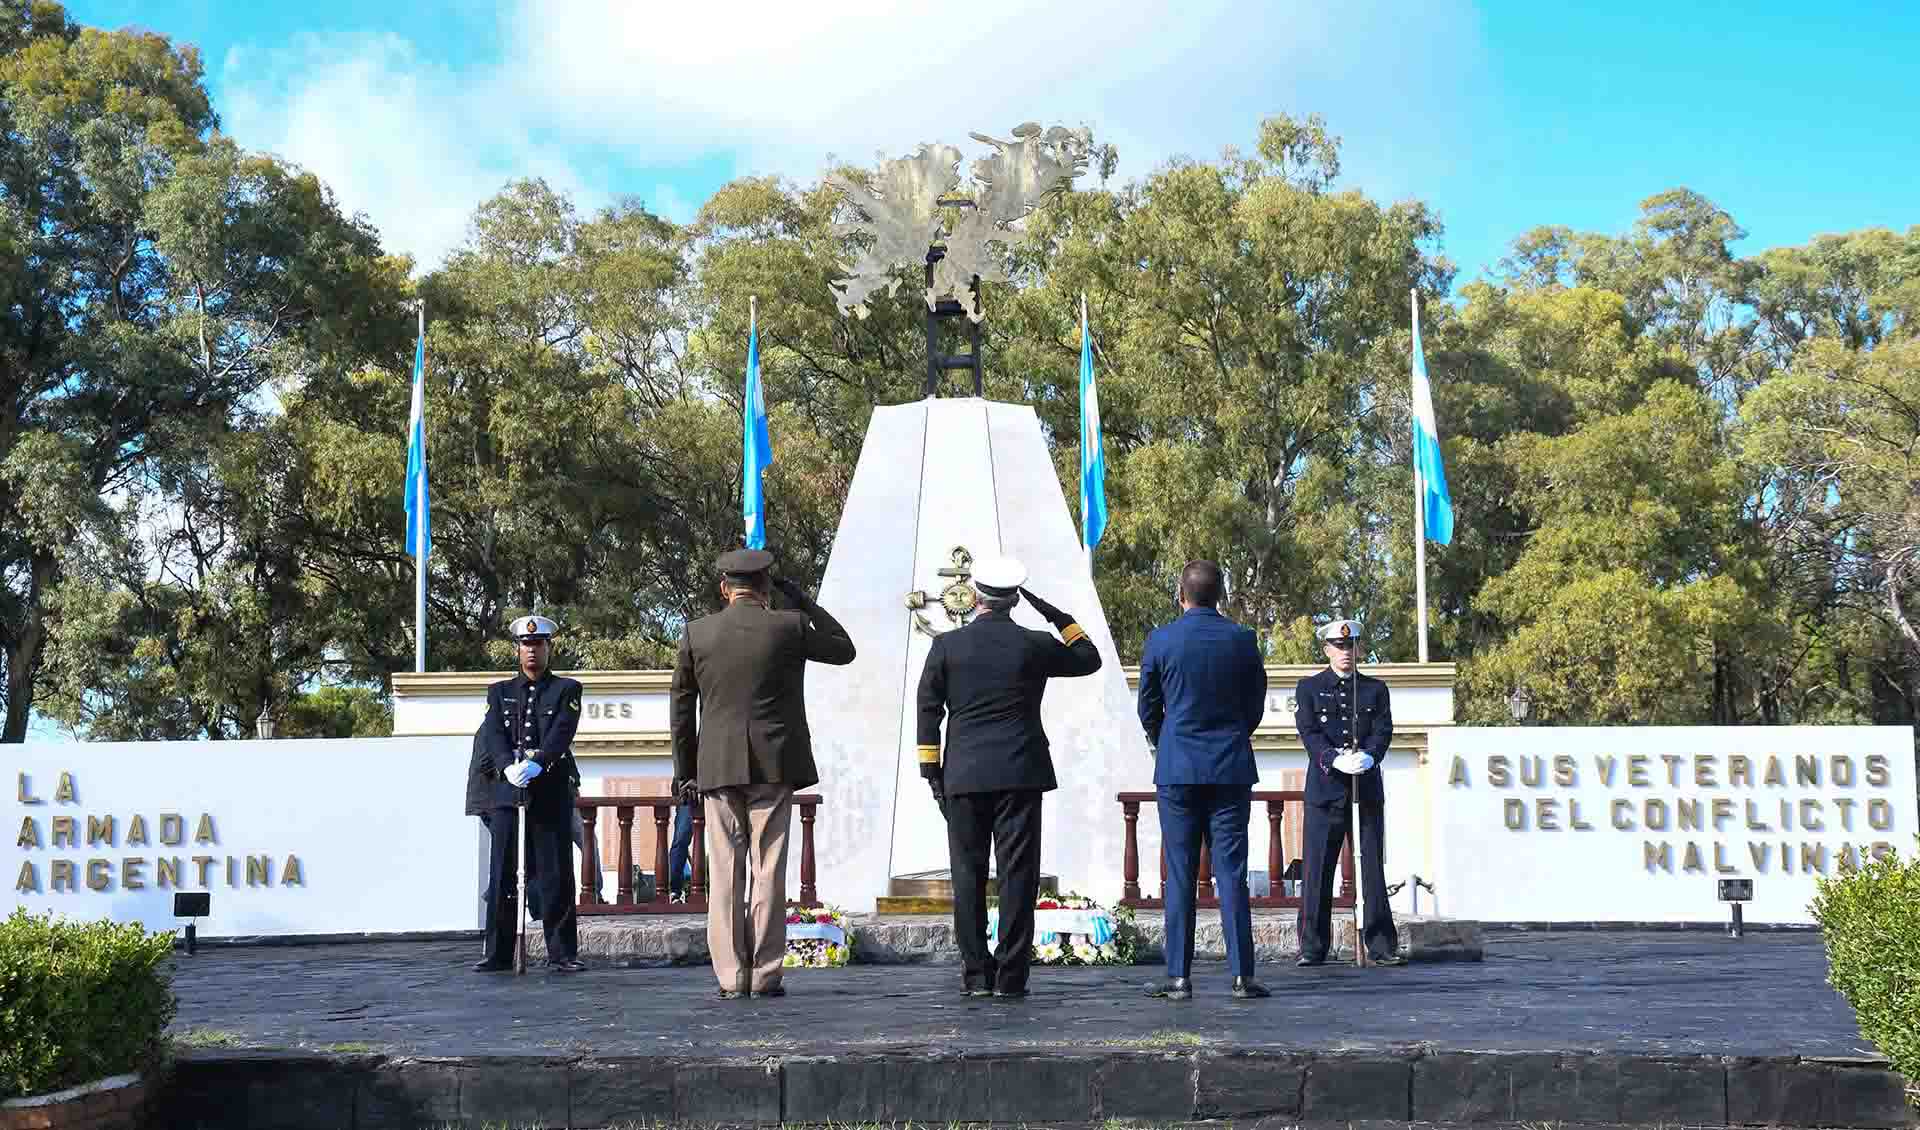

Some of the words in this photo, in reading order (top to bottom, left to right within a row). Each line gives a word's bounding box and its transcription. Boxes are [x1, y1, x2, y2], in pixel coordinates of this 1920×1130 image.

[17, 771, 77, 804] LA
[1448, 754, 1469, 787] A
[1488, 754, 1575, 787] SUS
[1596, 754, 1888, 787] VETERANOS
[15, 812, 217, 849] ARMADA
[1503, 797, 1591, 831] DEL
[1610, 797, 1890, 831] CONFLICTO
[15, 853, 304, 891] ARGENTINA
